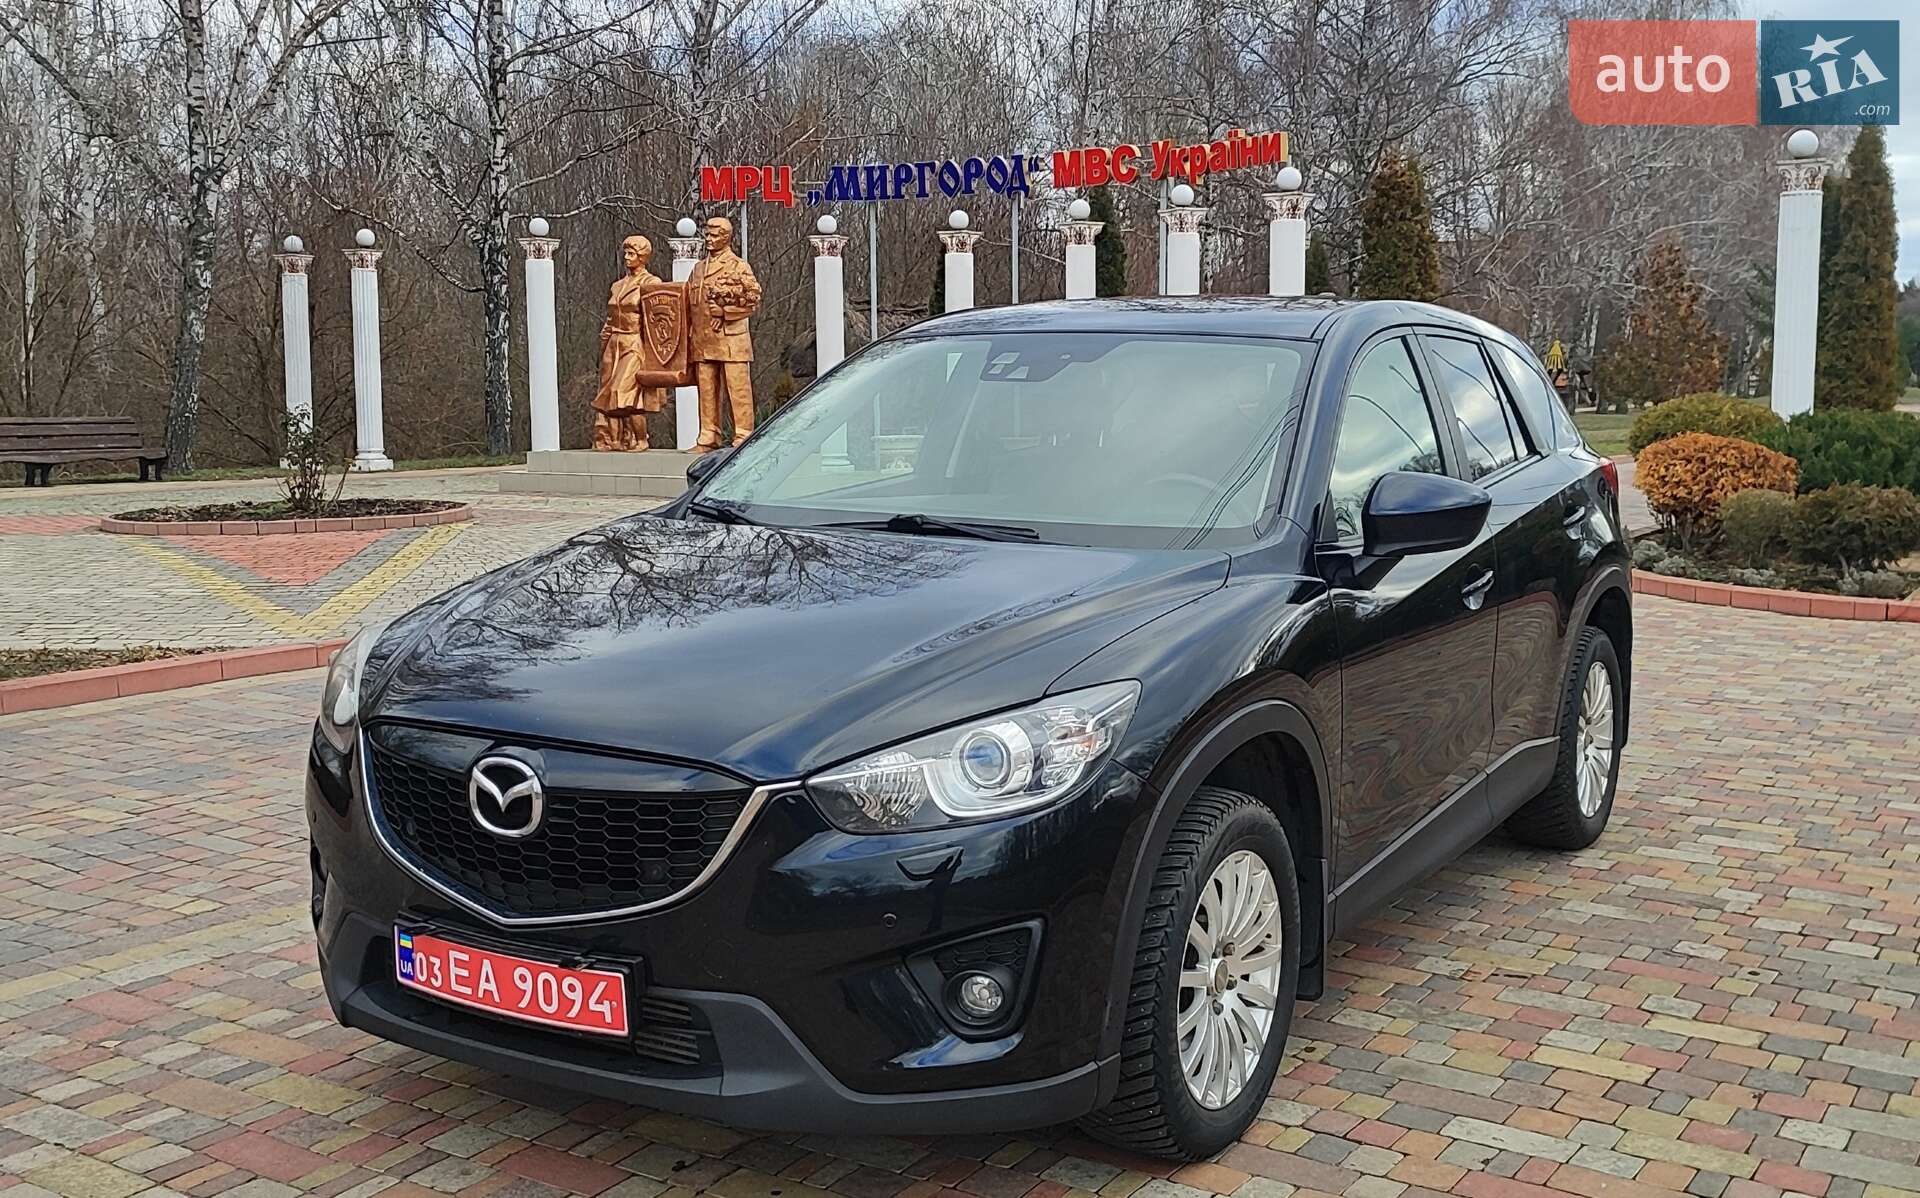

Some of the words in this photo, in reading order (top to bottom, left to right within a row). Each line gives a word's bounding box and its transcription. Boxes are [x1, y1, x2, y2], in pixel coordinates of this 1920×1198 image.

[701, 165, 794, 208] МРЦ
[1053, 144, 1141, 188] МВС
[1151, 128, 1288, 184] України
[400, 960, 414, 976] UA
[415, 952, 442, 988] 03
[449, 950, 500, 1003] EA
[513, 967, 612, 1024] 9094
